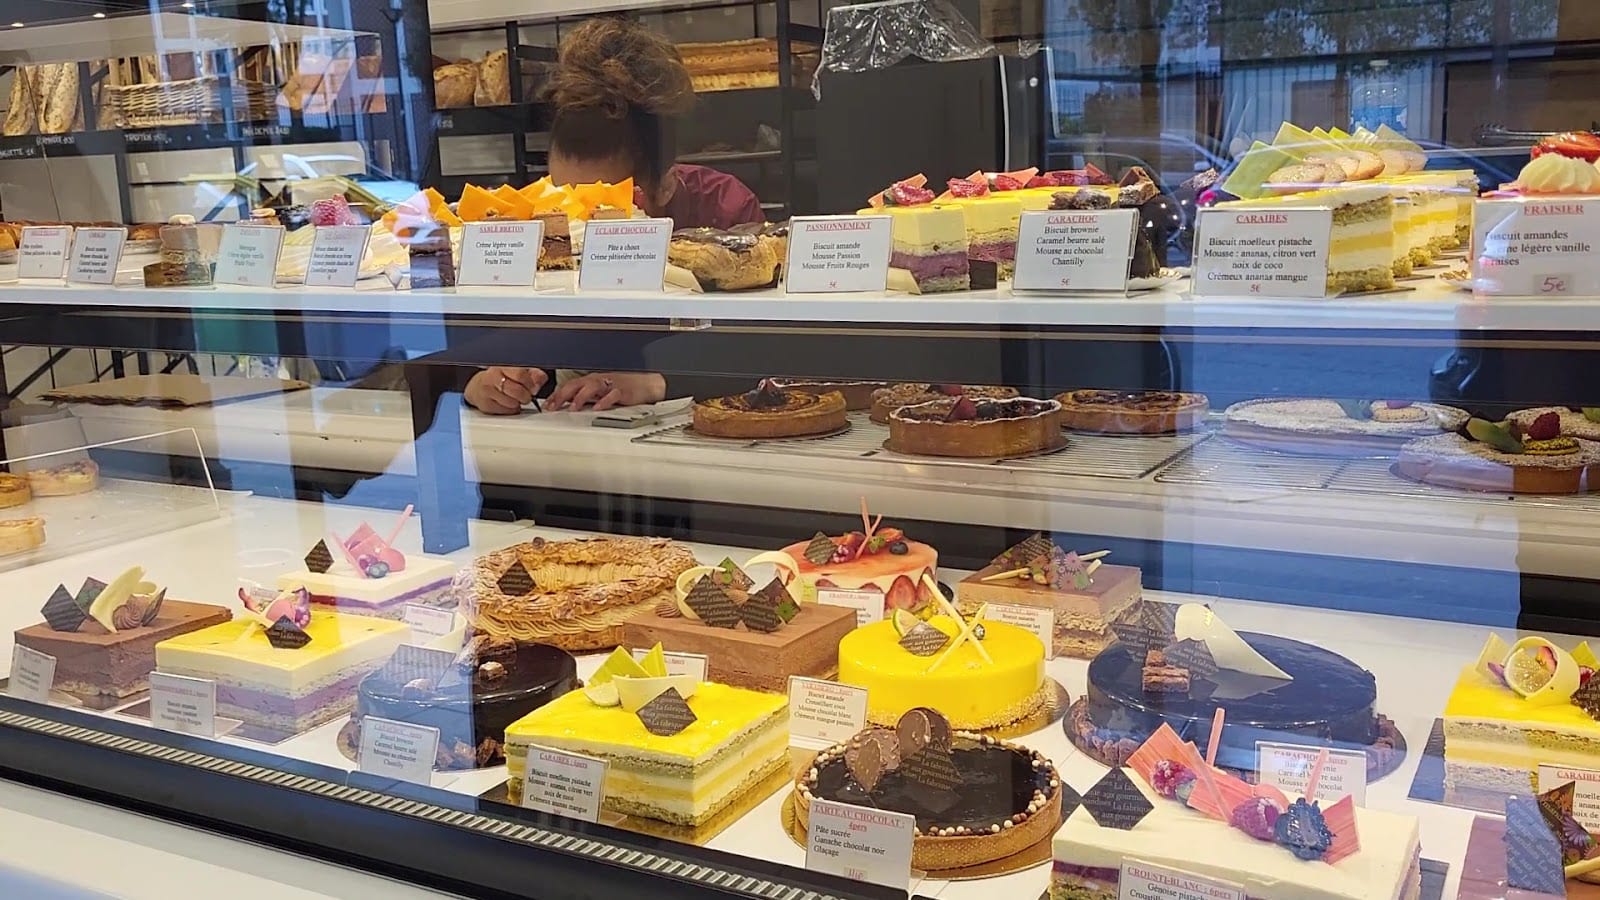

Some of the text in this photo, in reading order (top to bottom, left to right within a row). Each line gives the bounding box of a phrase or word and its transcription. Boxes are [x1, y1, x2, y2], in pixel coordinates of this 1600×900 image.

[1523, 205, 1584, 215] FRAISIER
[1048, 215, 1097, 224] CARACHOC
[806, 222, 872, 232] PASSIONNEMENT
[1524, 231, 1568, 239] amandes
[1209, 238, 1236, 246] Biscuit
[1279, 238, 1312, 247] pistache
[1522, 242, 1552, 254] légère
[1556, 243, 1590, 252] vanille
[1052, 257, 1084, 266] Chantilly
[1208, 272, 1242, 281] Crémeux
[1276, 274, 1308, 283] mangue
[815, 805, 840, 814] TARTE
[855, 812, 899, 827] CHOCOLAT
[816, 825, 851, 838] Pâte sucrée
[814, 845, 840, 857] Glaçage
[815, 836, 885, 855] Ganache chocolat noir
[1128, 867, 1202, 891] CROUSTI-BLANC
